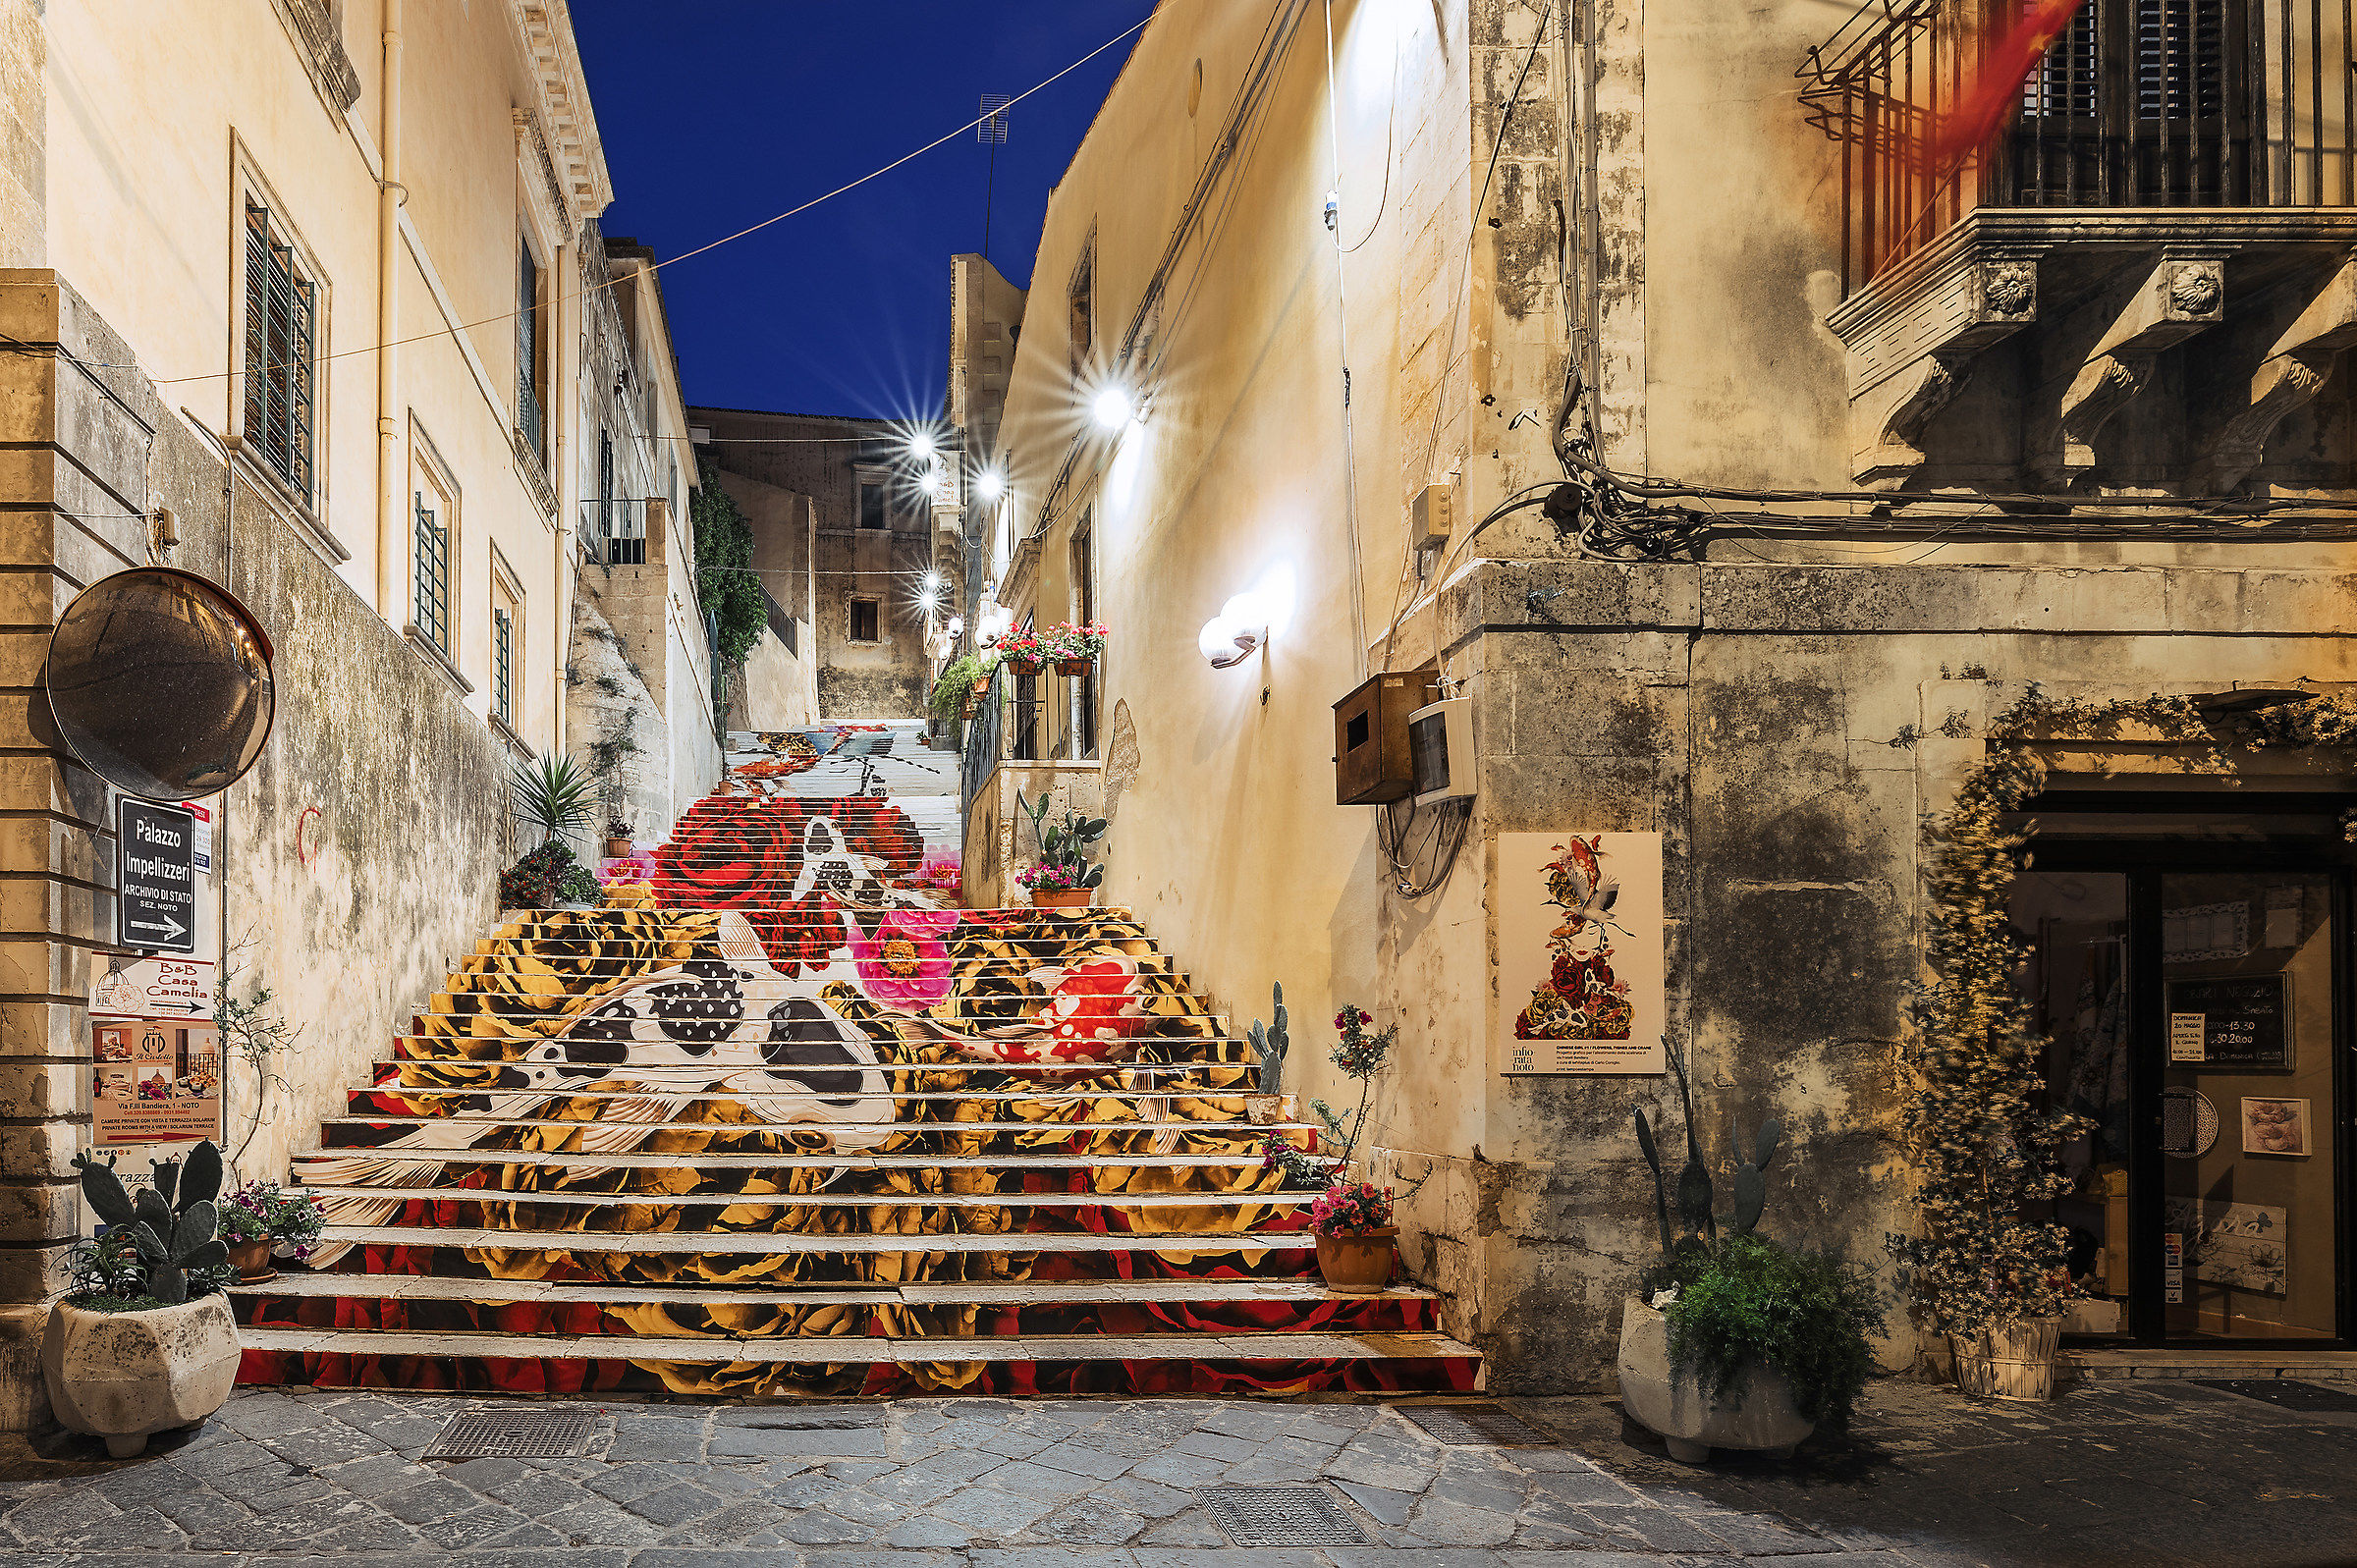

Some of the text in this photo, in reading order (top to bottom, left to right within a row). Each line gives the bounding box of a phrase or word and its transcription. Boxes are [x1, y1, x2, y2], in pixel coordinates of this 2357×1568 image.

[137, 819, 181, 848] Palazzo
[127, 850, 190, 882] Impellizzeri
[125, 884, 192, 904] ARCHIVIO DI STATO
[139, 900, 178, 912] SEZ. NOTO
[160, 963, 197, 975] B&B
[158, 975, 197, 986] Casa
[146, 986, 208, 999] Camelia
[1512, 1046, 1534, 1056] infio
[115, 1172, 155, 1182] razza
